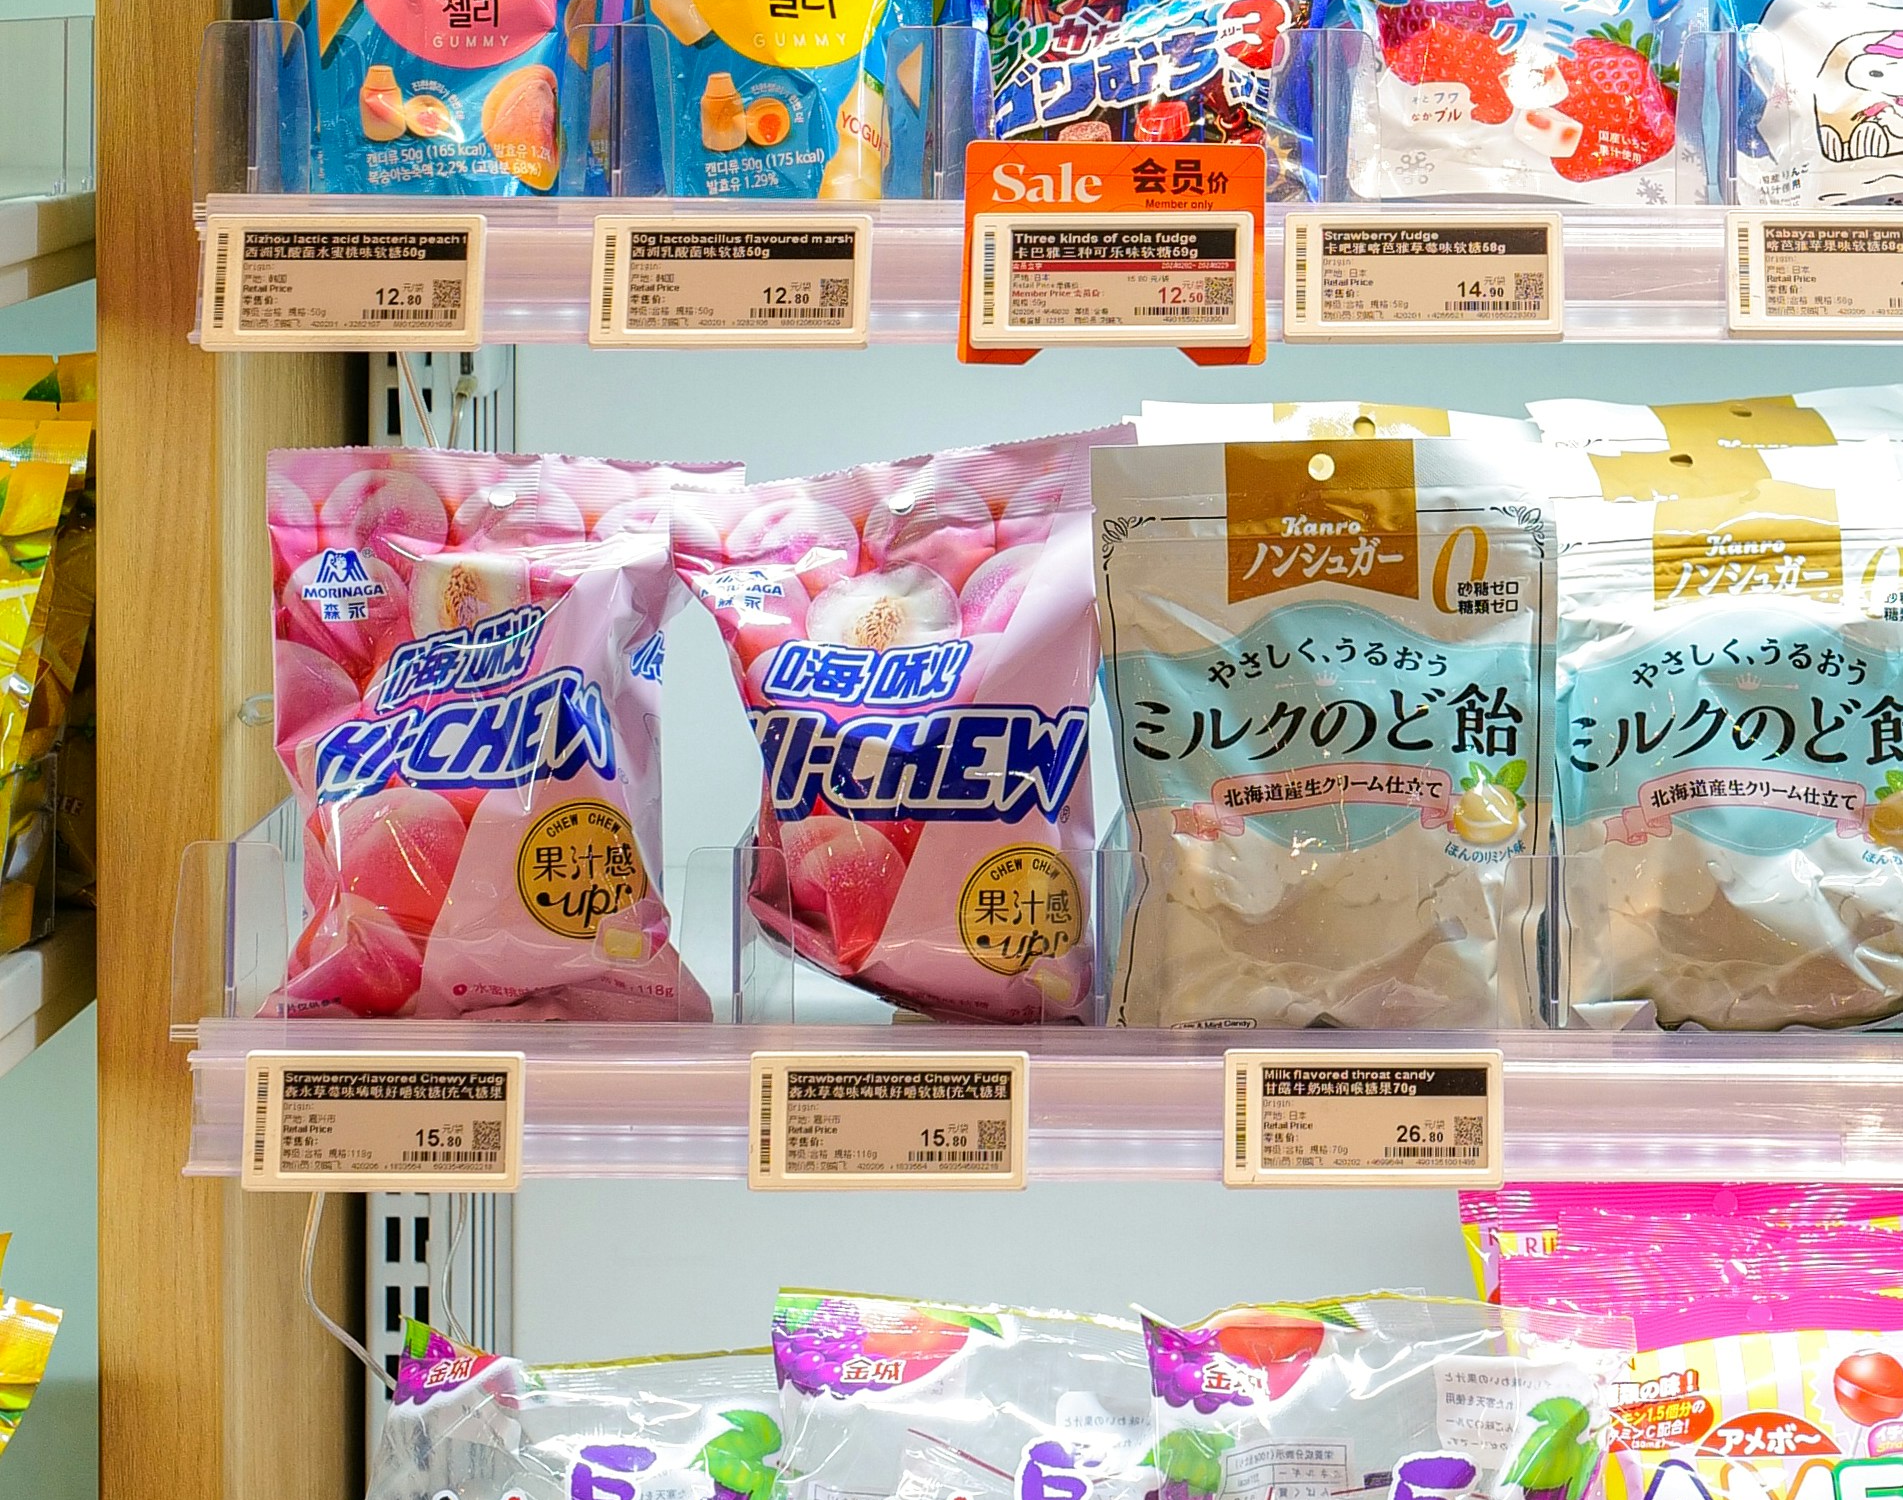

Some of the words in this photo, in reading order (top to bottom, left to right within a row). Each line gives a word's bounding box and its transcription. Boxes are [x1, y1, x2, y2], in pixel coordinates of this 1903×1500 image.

[433, 35, 509, 49] GUMMY
[705, 161, 739, 176] 캔디류
[741, 159, 763, 174] 50g
[766, 152, 791, 169] (175
[793, 149, 824, 166] kcal)
[991, 164, 1103, 204] Sale
[1131, 159, 1229, 197] 会员价
[1145, 199, 1188, 210] Member
[1190, 200, 1214, 212] only
[1014, 234, 1056, 243] Three
[1059, 233, 1099, 243] kinds
[1102, 233, 1119, 243] of
[1121, 233, 1152, 243] cola
[1155, 233, 1197, 245] fudge
[375, 288, 422, 306] 12.80
[1158, 286, 1204, 304] 12.50
[1242, 546, 1403, 583] ノンシュガー
[303, 584, 385, 599] MORINAGA
[384, 606, 544, 704] 嗨啾
[1207, 638, 1448, 691] やさしく、うるおう
[316, 671, 614, 800] HI-CHEW
[1134, 684, 1520, 762] ミルクのど飴
[1224, 774, 1443, 808] 北海道産生クリーム仕立て
[533, 845, 636, 882] 果汁感
[1264, 1070, 1291, 1081] Milk
[1293, 1070, 1349, 1081] flavored
[1351, 1070, 1391, 1081] throat
[1393, 1070, 1436, 1084] candy
[415, 1128, 463, 1148] 15.80
